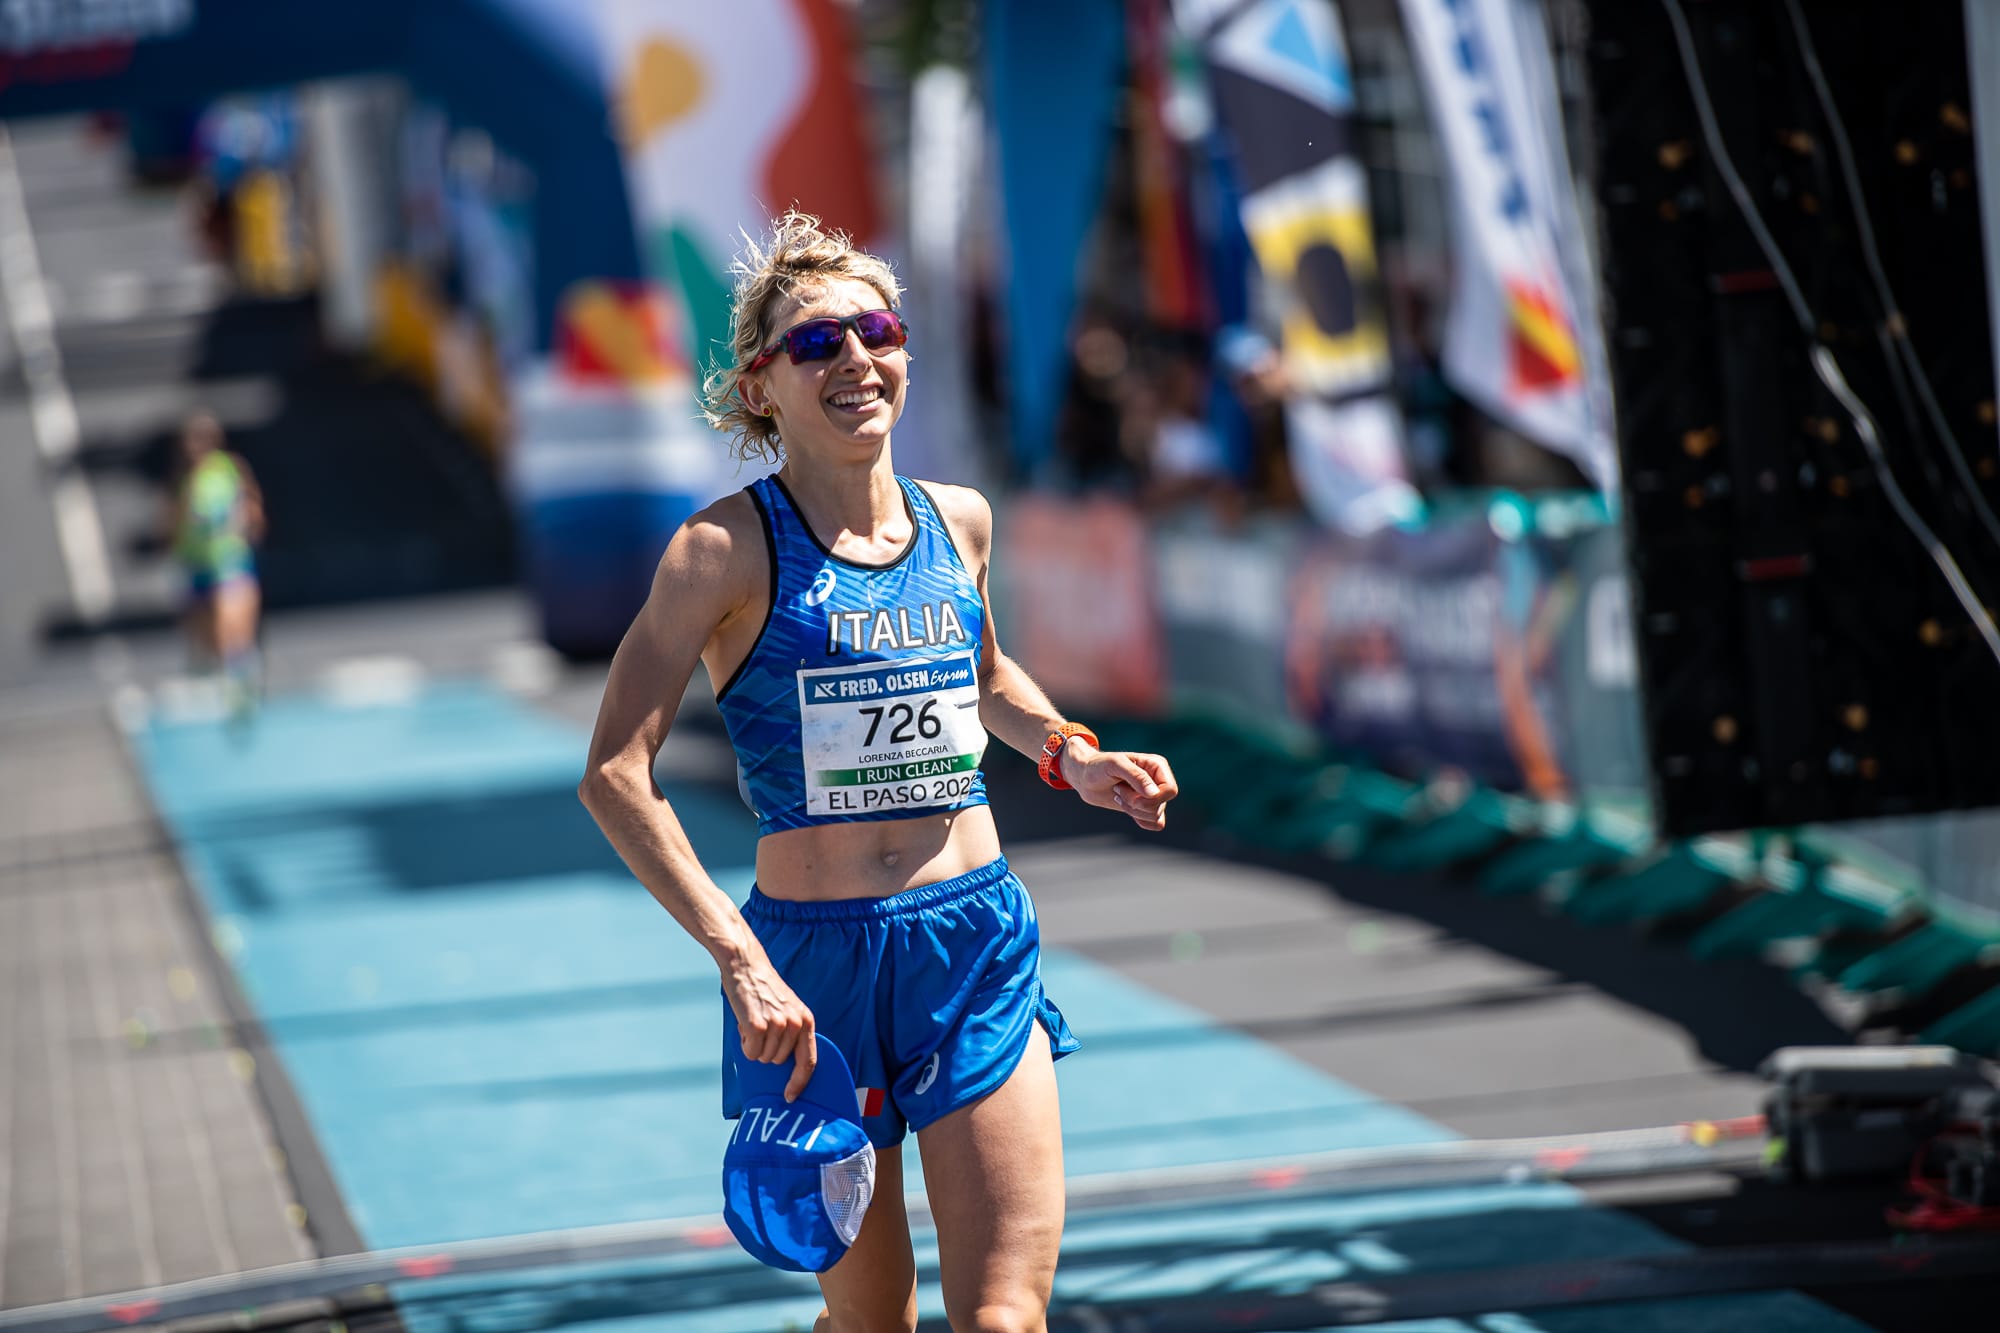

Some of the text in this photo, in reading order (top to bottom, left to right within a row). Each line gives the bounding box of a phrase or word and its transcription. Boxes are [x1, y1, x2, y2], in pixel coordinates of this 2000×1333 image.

[826, 600, 967, 656] ITALIA
[840, 668, 970, 697] FRED. OLSEN Express
[858, 698, 942, 748] 726
[858, 744, 949, 764] LORENZA BECCARIA
[829, 774, 976, 810] EL PASO 202
[857, 770, 862, 784] I
[867, 766, 900, 783] RUN
[732, 1107, 826, 1151] ITALI
